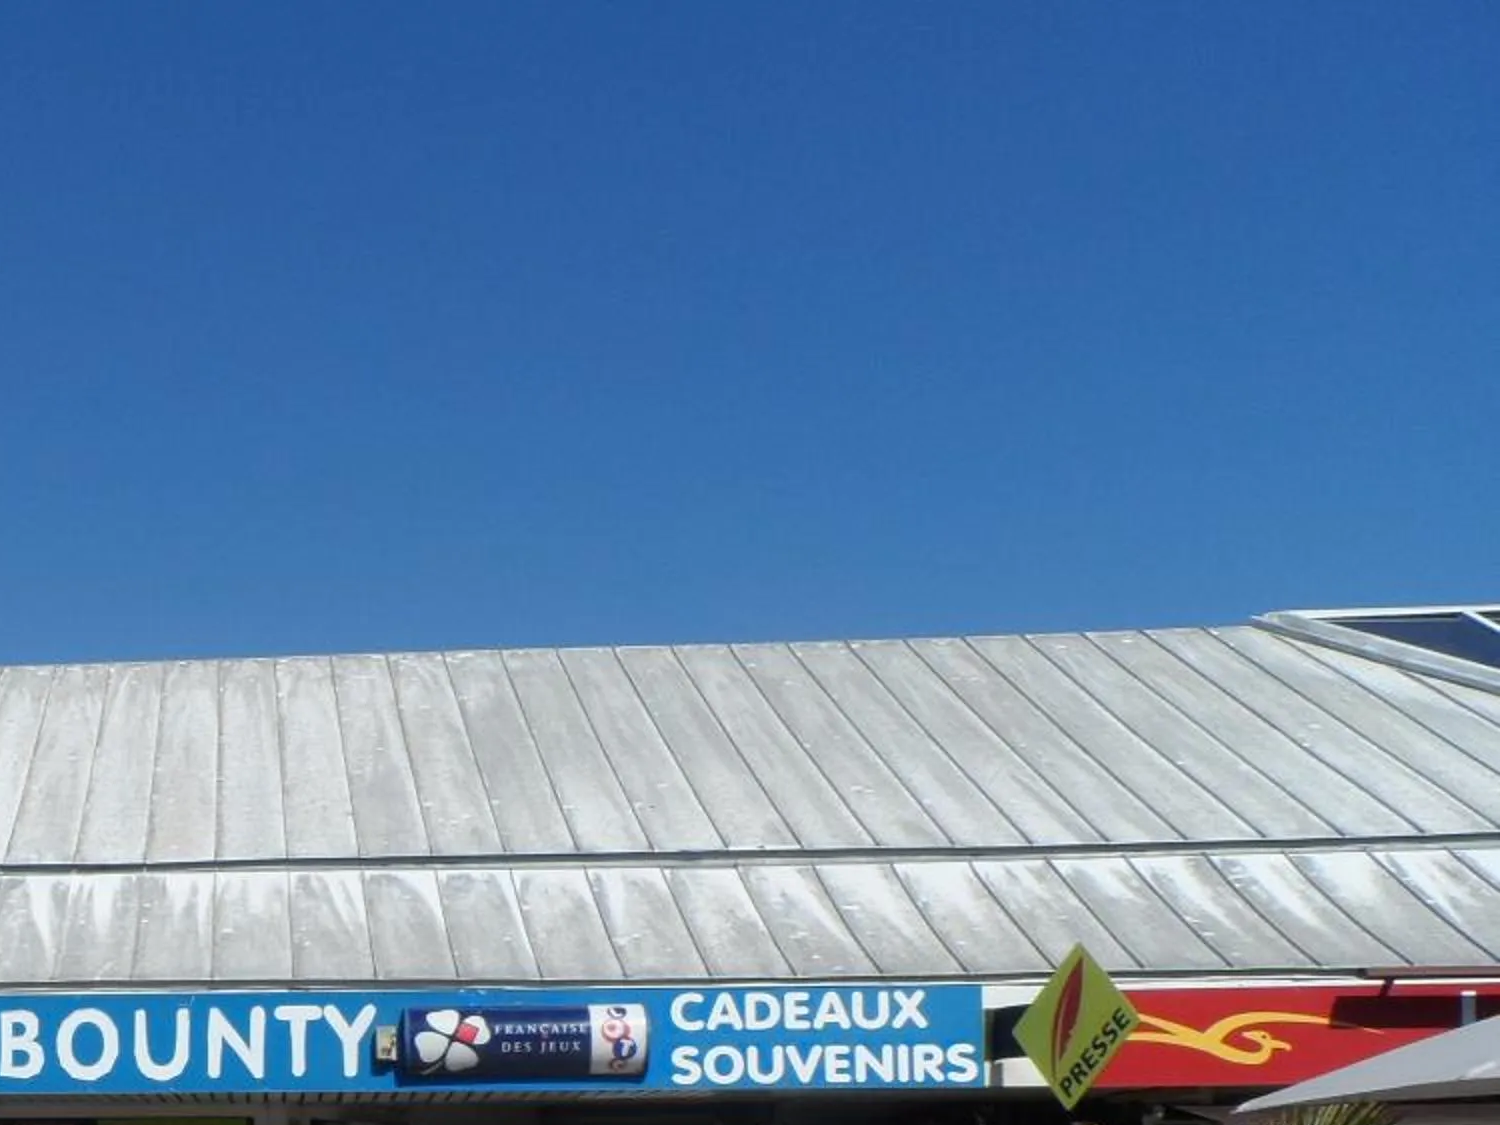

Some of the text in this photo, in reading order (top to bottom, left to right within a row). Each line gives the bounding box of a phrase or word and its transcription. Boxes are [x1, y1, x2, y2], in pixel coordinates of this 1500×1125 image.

[494, 1022, 590, 1038] FRANÇAISE
[670, 990, 928, 1032] CADEAUX
[501, 1041, 582, 1054] DES JEUX
[670, 1043, 979, 1085] SOUVENIRS
[1058, 1007, 1131, 1098] PRESSE
